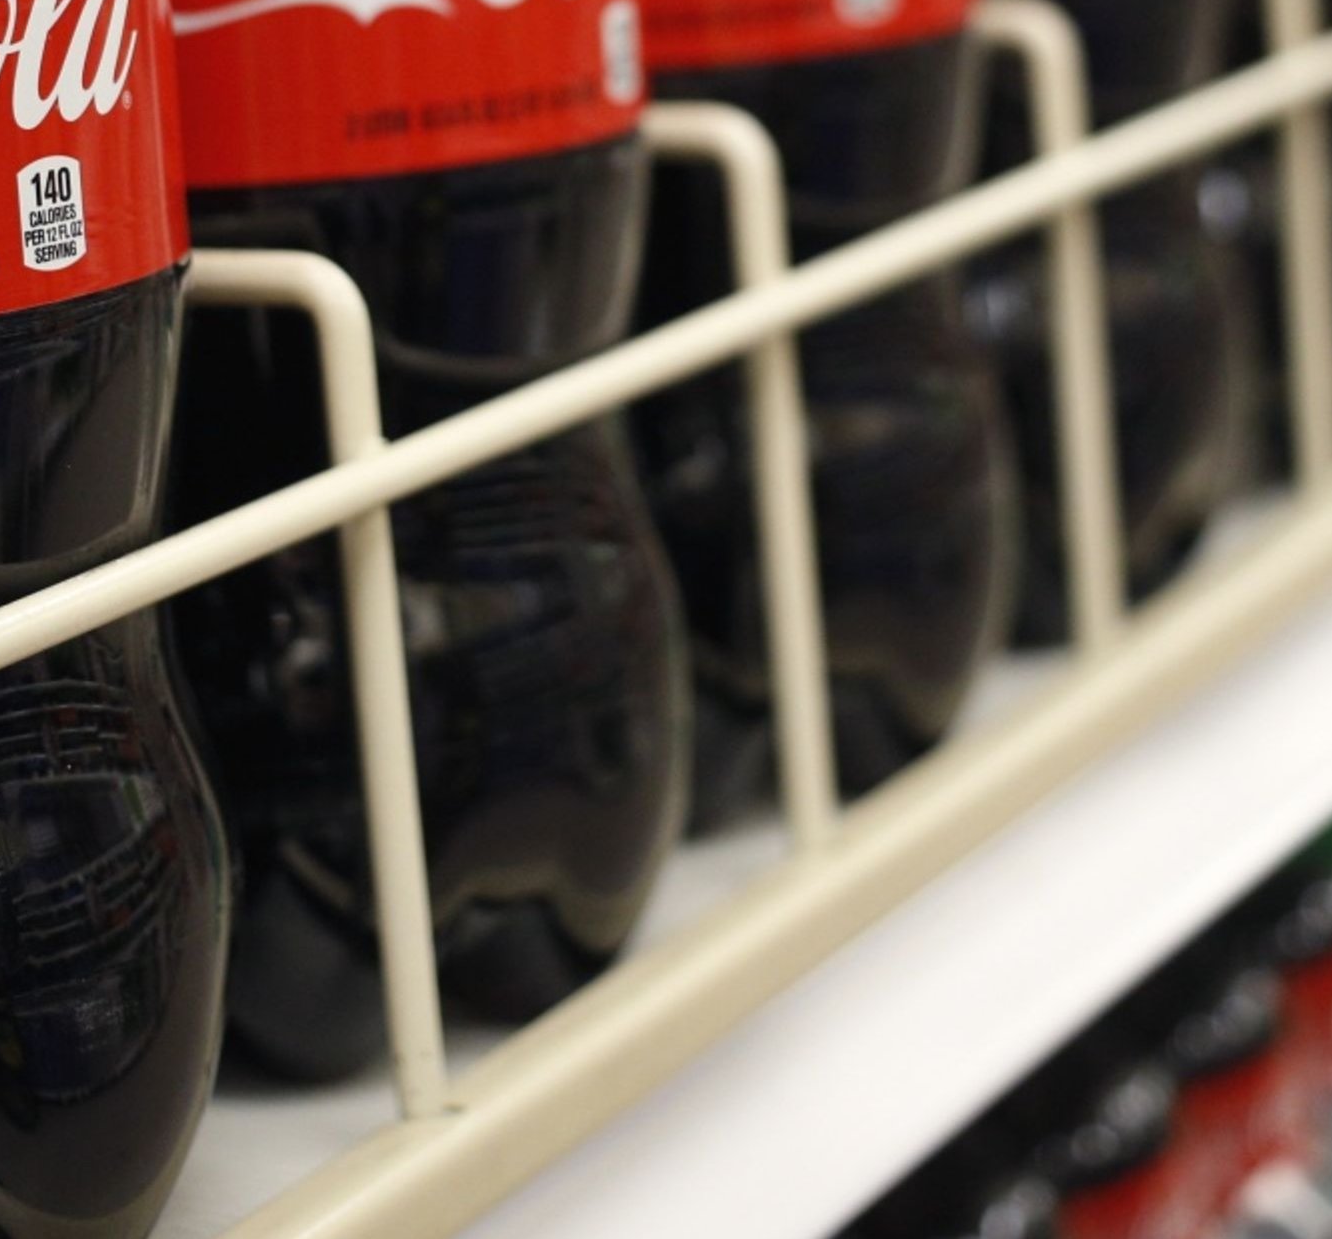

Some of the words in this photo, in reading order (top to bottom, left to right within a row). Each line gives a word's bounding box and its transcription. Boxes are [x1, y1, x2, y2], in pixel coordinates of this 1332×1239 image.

[31, 166, 71, 207] 140
[29, 203, 77, 228] CALORIES
[24, 229, 45, 248] PER
[46, 226, 57, 243] 12
[58, 224, 70, 240] FL
[70, 221, 83, 238] OZ
[34, 240, 77, 264] SERVING
